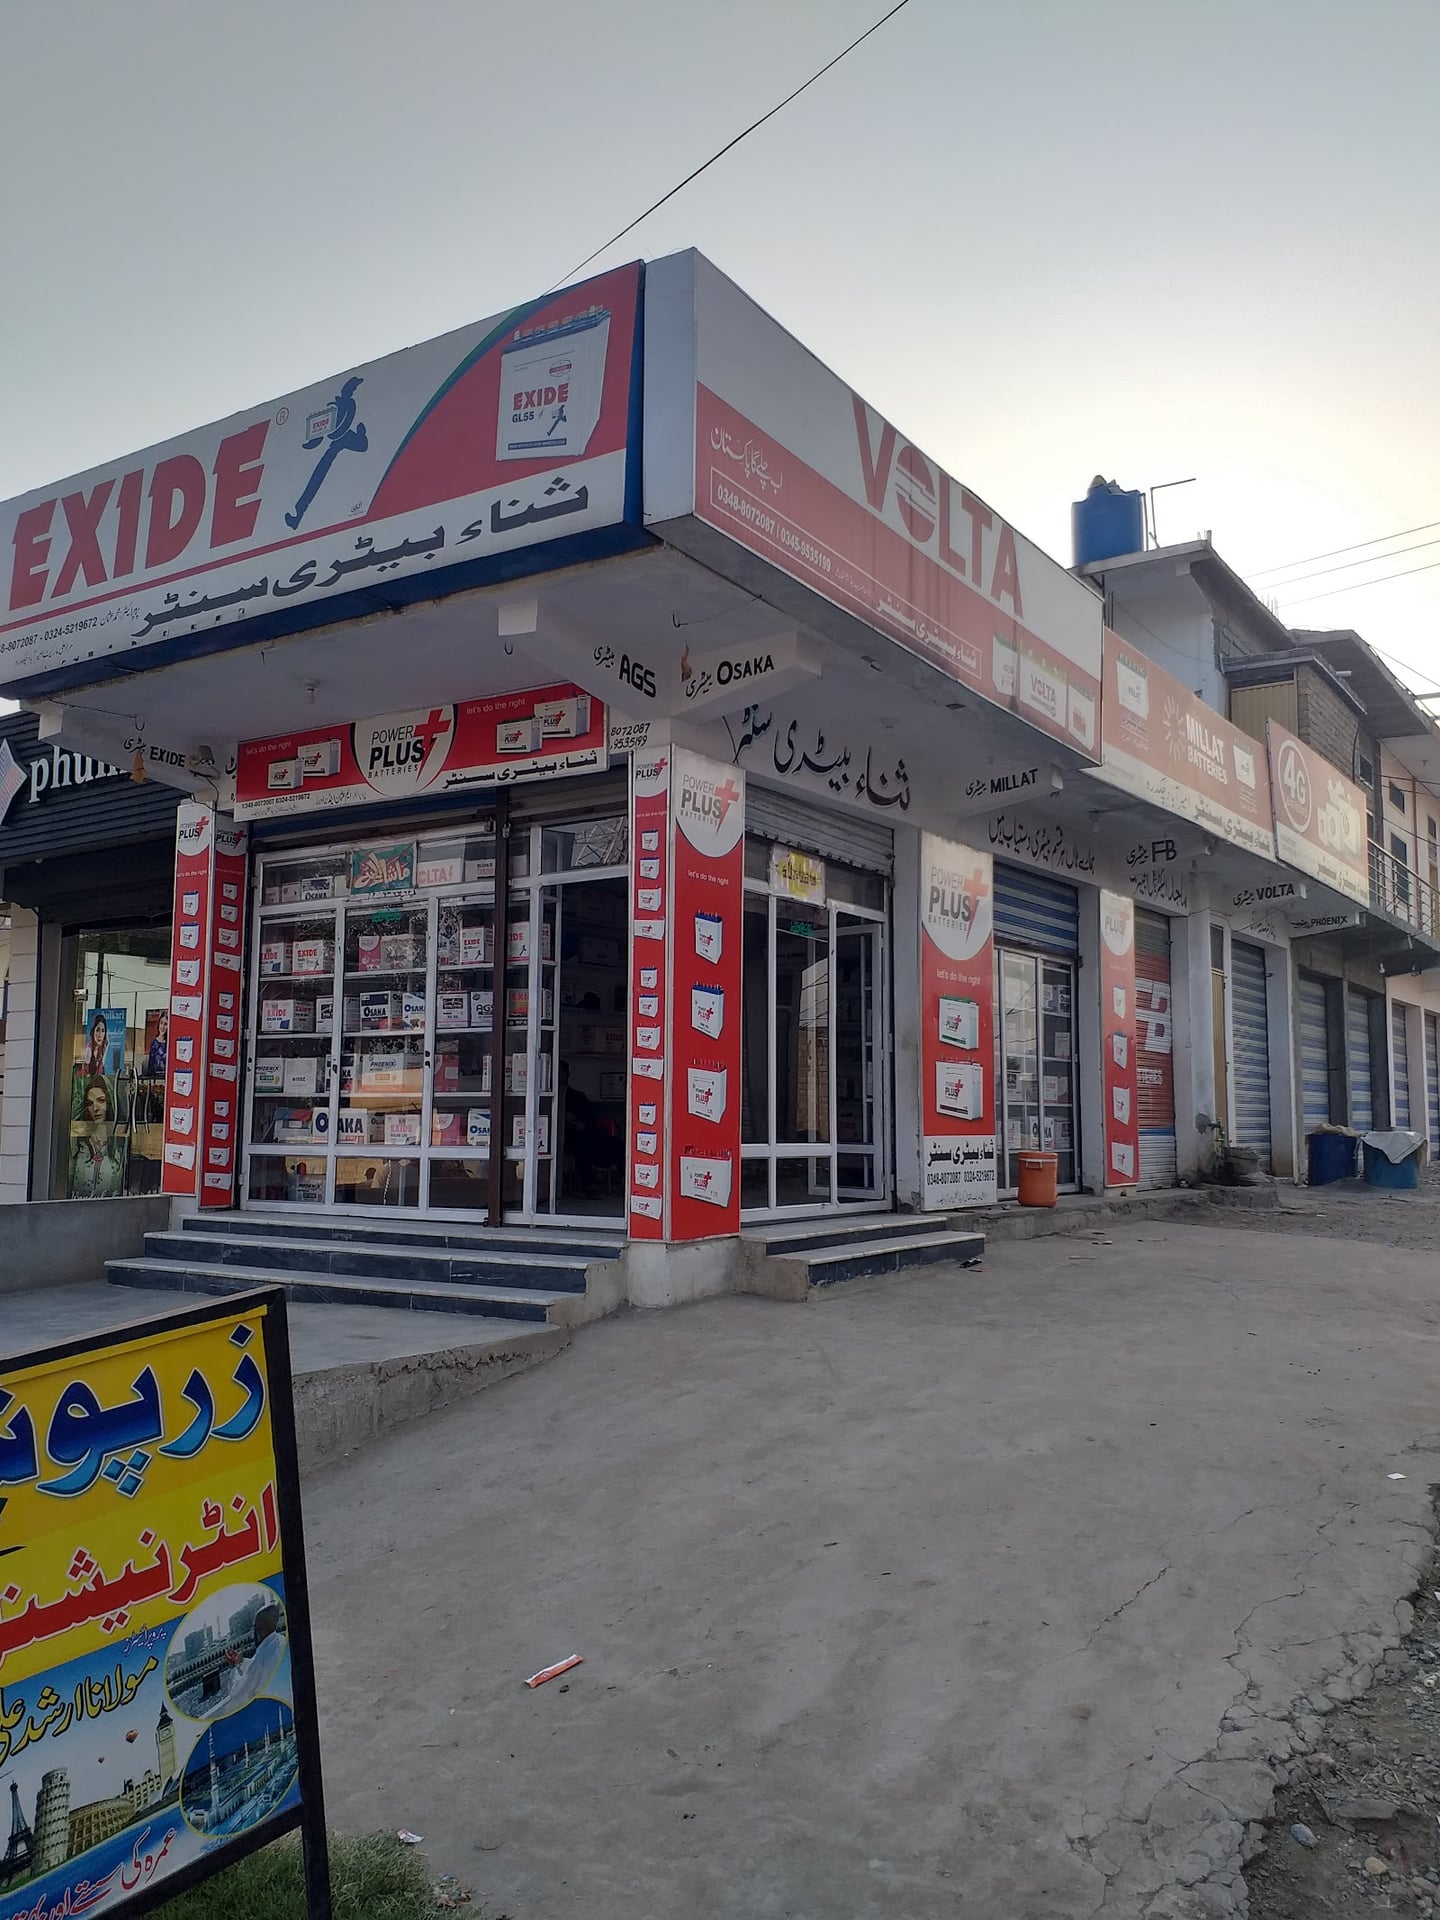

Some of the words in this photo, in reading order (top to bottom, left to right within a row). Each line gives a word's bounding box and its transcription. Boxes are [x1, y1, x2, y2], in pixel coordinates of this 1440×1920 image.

[513, 382, 569, 411] EXIDE
[512, 411, 535, 423] GL55
[9, 419, 270, 611] EXIDE
[454, 476, 589, 546] ثناء
[717, 484, 775, 535] 0348-8072087
[852, 392, 1023, 619] VOLTA
[273, 526, 445, 597] بیٹری
[131, 576, 268, 637] سنٹر
[44, 616, 98, 640] 0324-5219672
[618, 653, 657, 698] AGS
[717, 654, 775, 685] OSAKA
[1031, 673, 1057, 706] VOLTA
[466, 704, 482, 715] let's
[483, 703, 494, 712] do
[494, 701, 507, 710] the
[508, 698, 526, 711] right
[371, 725, 414, 745] POWER
[610, 722, 651, 736] 8072087
[1186, 712, 1225, 766] MILLAT
[150, 746, 187, 768] EXIDE
[369, 739, 425, 770] PLUS
[558, 750, 598, 771] ثناء
[1188, 745, 1228, 786] BATTERIES
[368, 763, 419, 779] BATTERIES
[442, 771, 495, 789] سنٹر
[497, 760, 557, 781] بیٹری
[635, 769, 658, 779] PLUS
[990, 768, 1038, 794] MILLAT
[1283, 750, 1307, 805] 4G
[683, 774, 715, 794] POWER
[680, 788, 724, 819] PLUS
[178, 827, 200, 839] PLUS
[216, 834, 237, 845] PLUS
[1152, 839, 1177, 863] FB
[700, 872, 708, 880] do
[708, 873, 717, 882] the
[717, 875, 729, 886] right
[930, 866, 963, 890] POWER
[1255, 883, 1295, 900] VOLTA
[928, 886, 972, 922] PLUS
[928, 914, 967, 932] BATTERIES
[1310, 914, 1348, 927] PHOENIX
[297, 948, 318, 958] EXIDE
[464, 938, 481, 946] EXIDE
[949, 971, 958, 980] do
[958, 972, 968, 982] the
[968, 975, 981, 986] right
[267, 1009, 287, 1017] EXIDE
[363, 1007, 387, 1017] OSAKA
[86, 1656, 159, 1719] مولانا
[10, 1683, 84, 1756] ارشد
